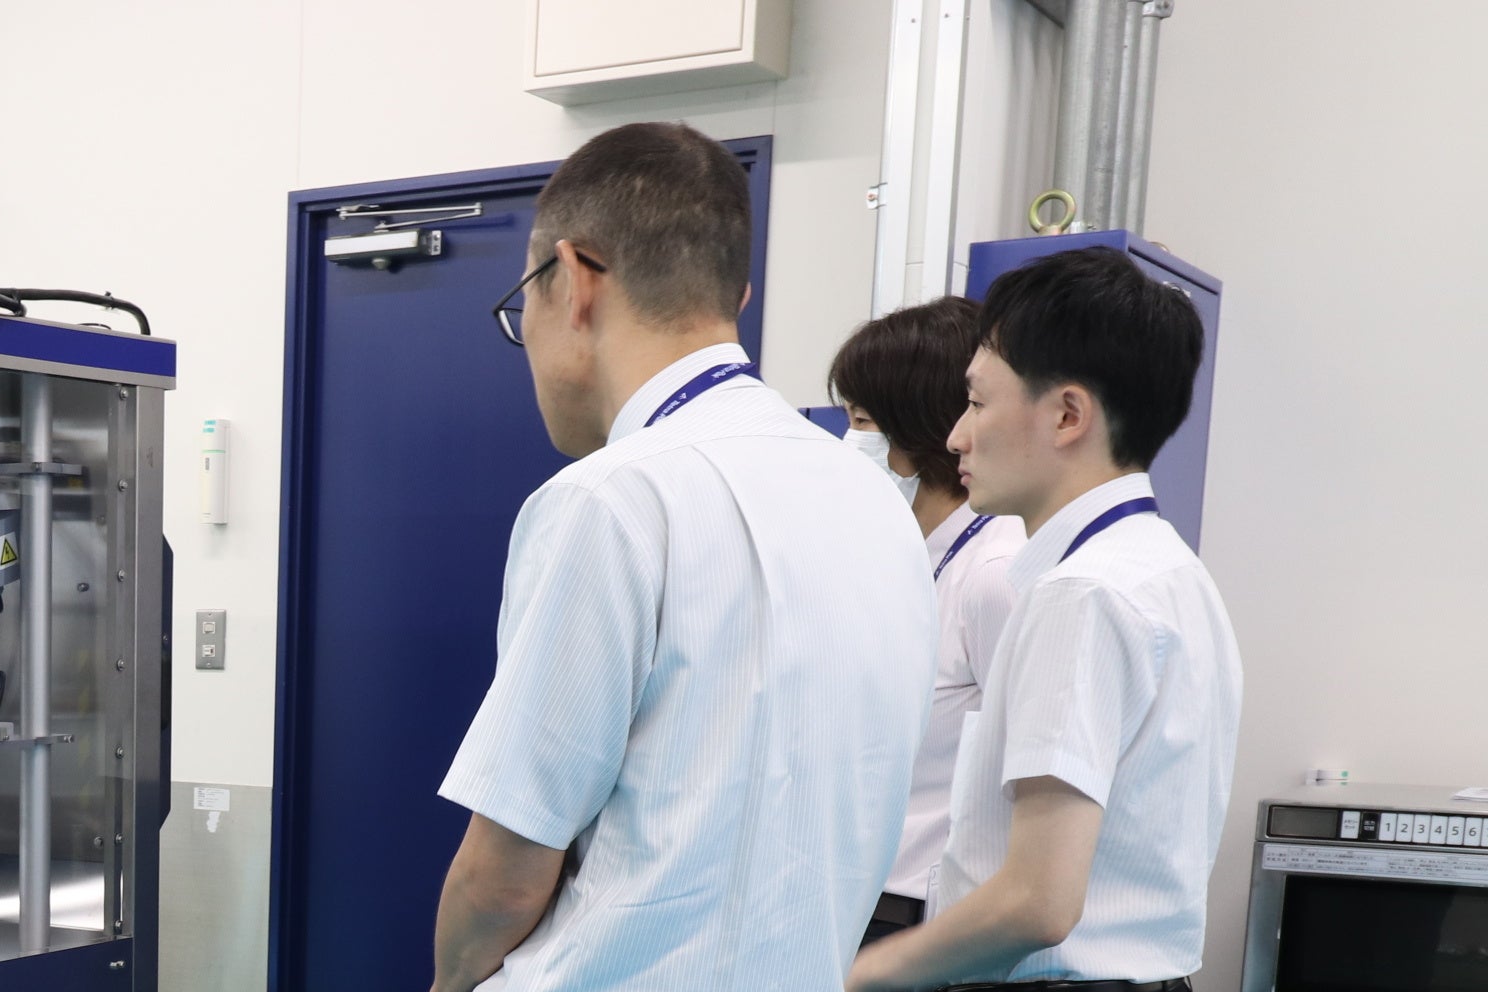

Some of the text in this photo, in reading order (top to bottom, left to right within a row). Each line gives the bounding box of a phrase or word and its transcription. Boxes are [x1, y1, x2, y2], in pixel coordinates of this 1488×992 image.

[1385, 823, 1391, 832] 1
[1400, 824, 1408, 833] 2
[1417, 824, 1425, 834] 3
[1434, 825, 1442, 834] 4
[1451, 826, 1459, 836] 5
[1468, 827, 1477, 837] 6
